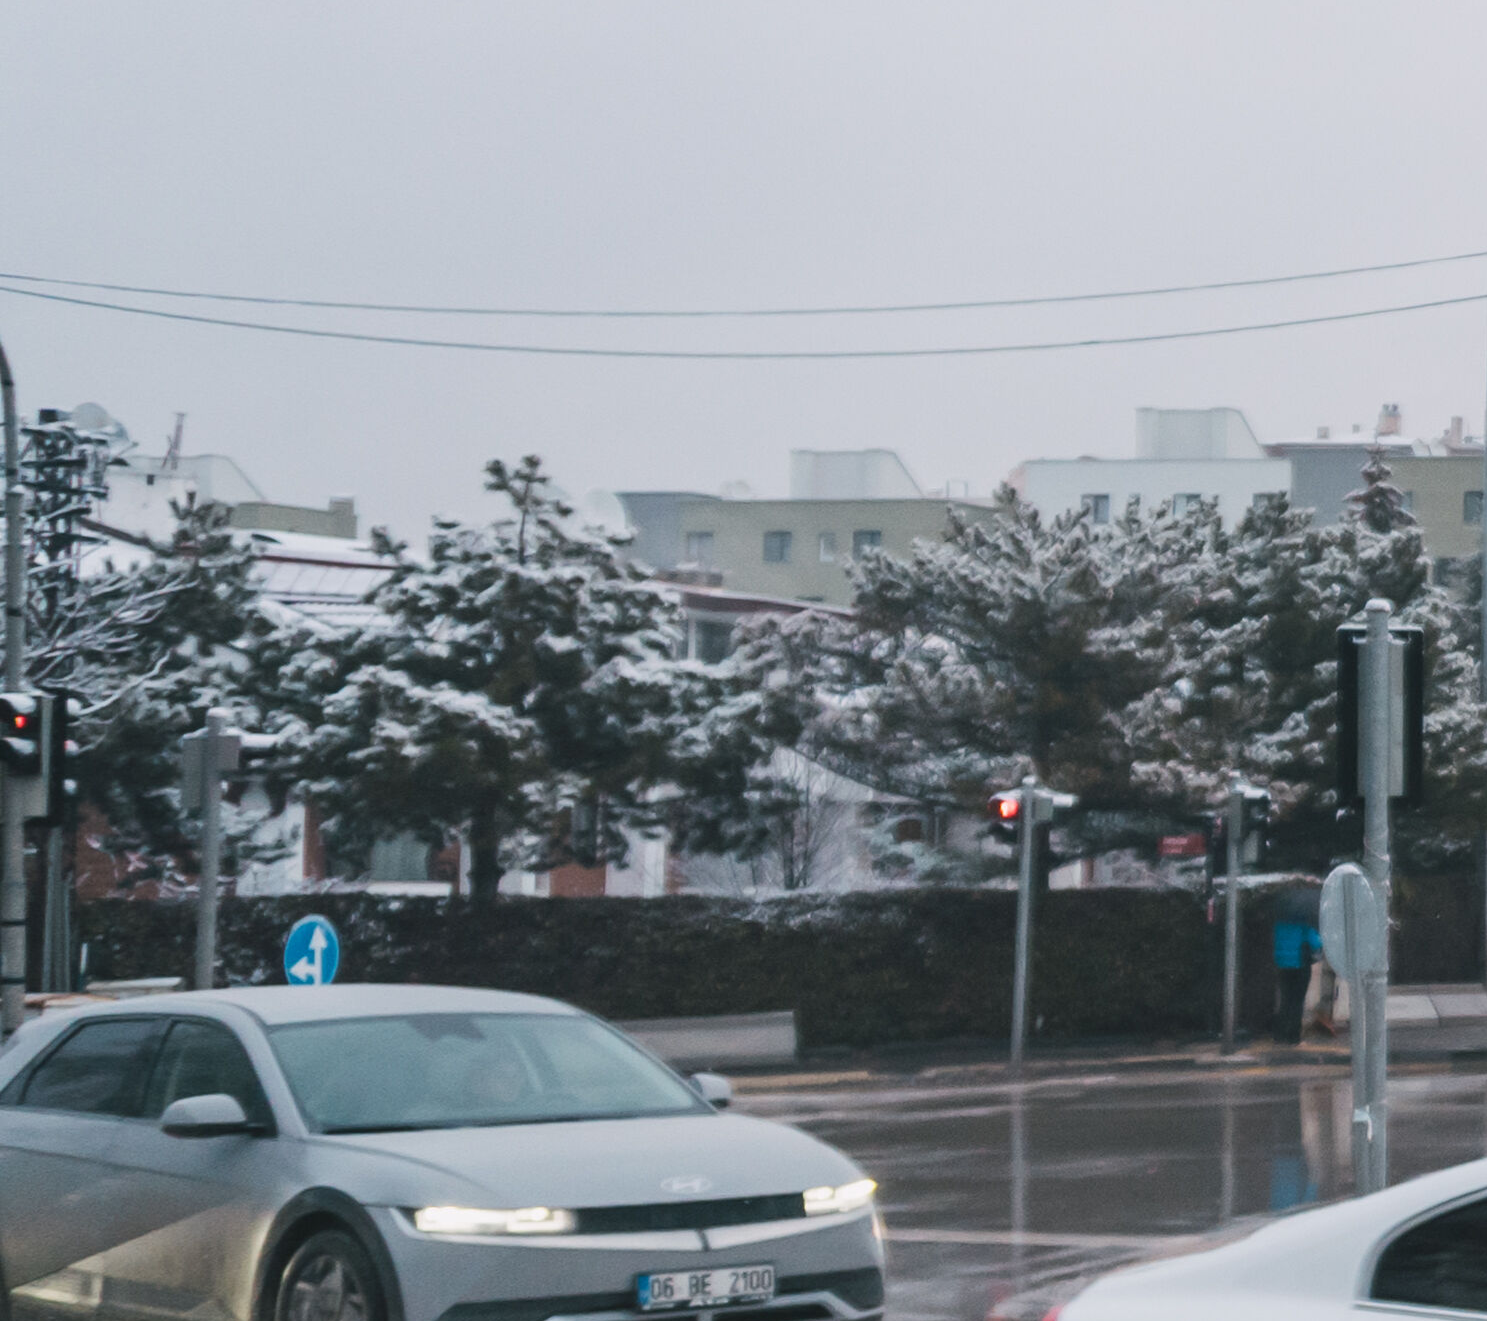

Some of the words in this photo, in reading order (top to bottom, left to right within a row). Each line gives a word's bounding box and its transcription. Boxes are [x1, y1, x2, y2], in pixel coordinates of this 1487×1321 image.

[650, 1277, 675, 1300] 06
[688, 1273, 712, 1296] BE
[728, 1270, 772, 1295] 2100
